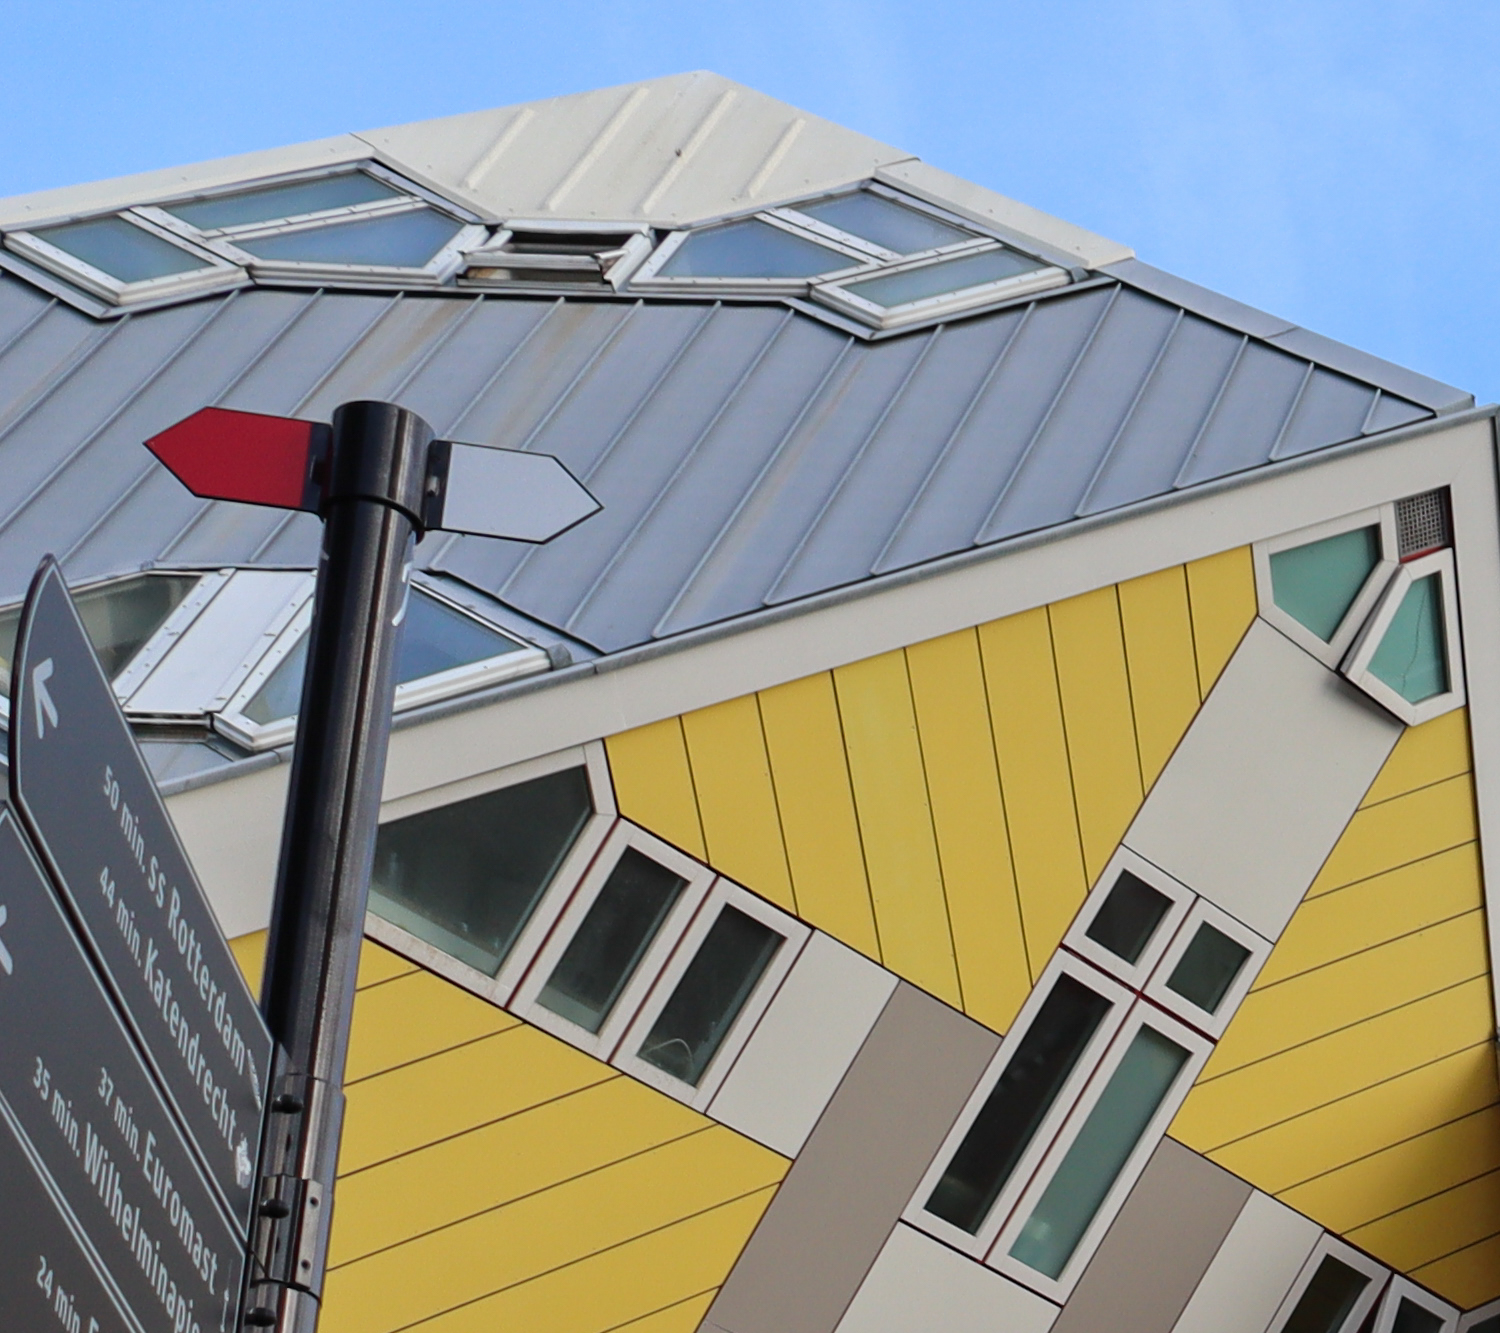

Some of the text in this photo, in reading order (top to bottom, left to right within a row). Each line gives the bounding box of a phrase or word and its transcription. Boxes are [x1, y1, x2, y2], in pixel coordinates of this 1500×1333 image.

[99, 866, 238, 1152] 44 min. Katendrecht
[102, 764, 246, 1076] 50 min. SS Rotterdam
[32, 1055, 51, 1100] 35
[51, 1088, 80, 1157] min.
[97, 1066, 219, 1295] 37 min. Euromast
[36, 1254, 54, 1299] 24
